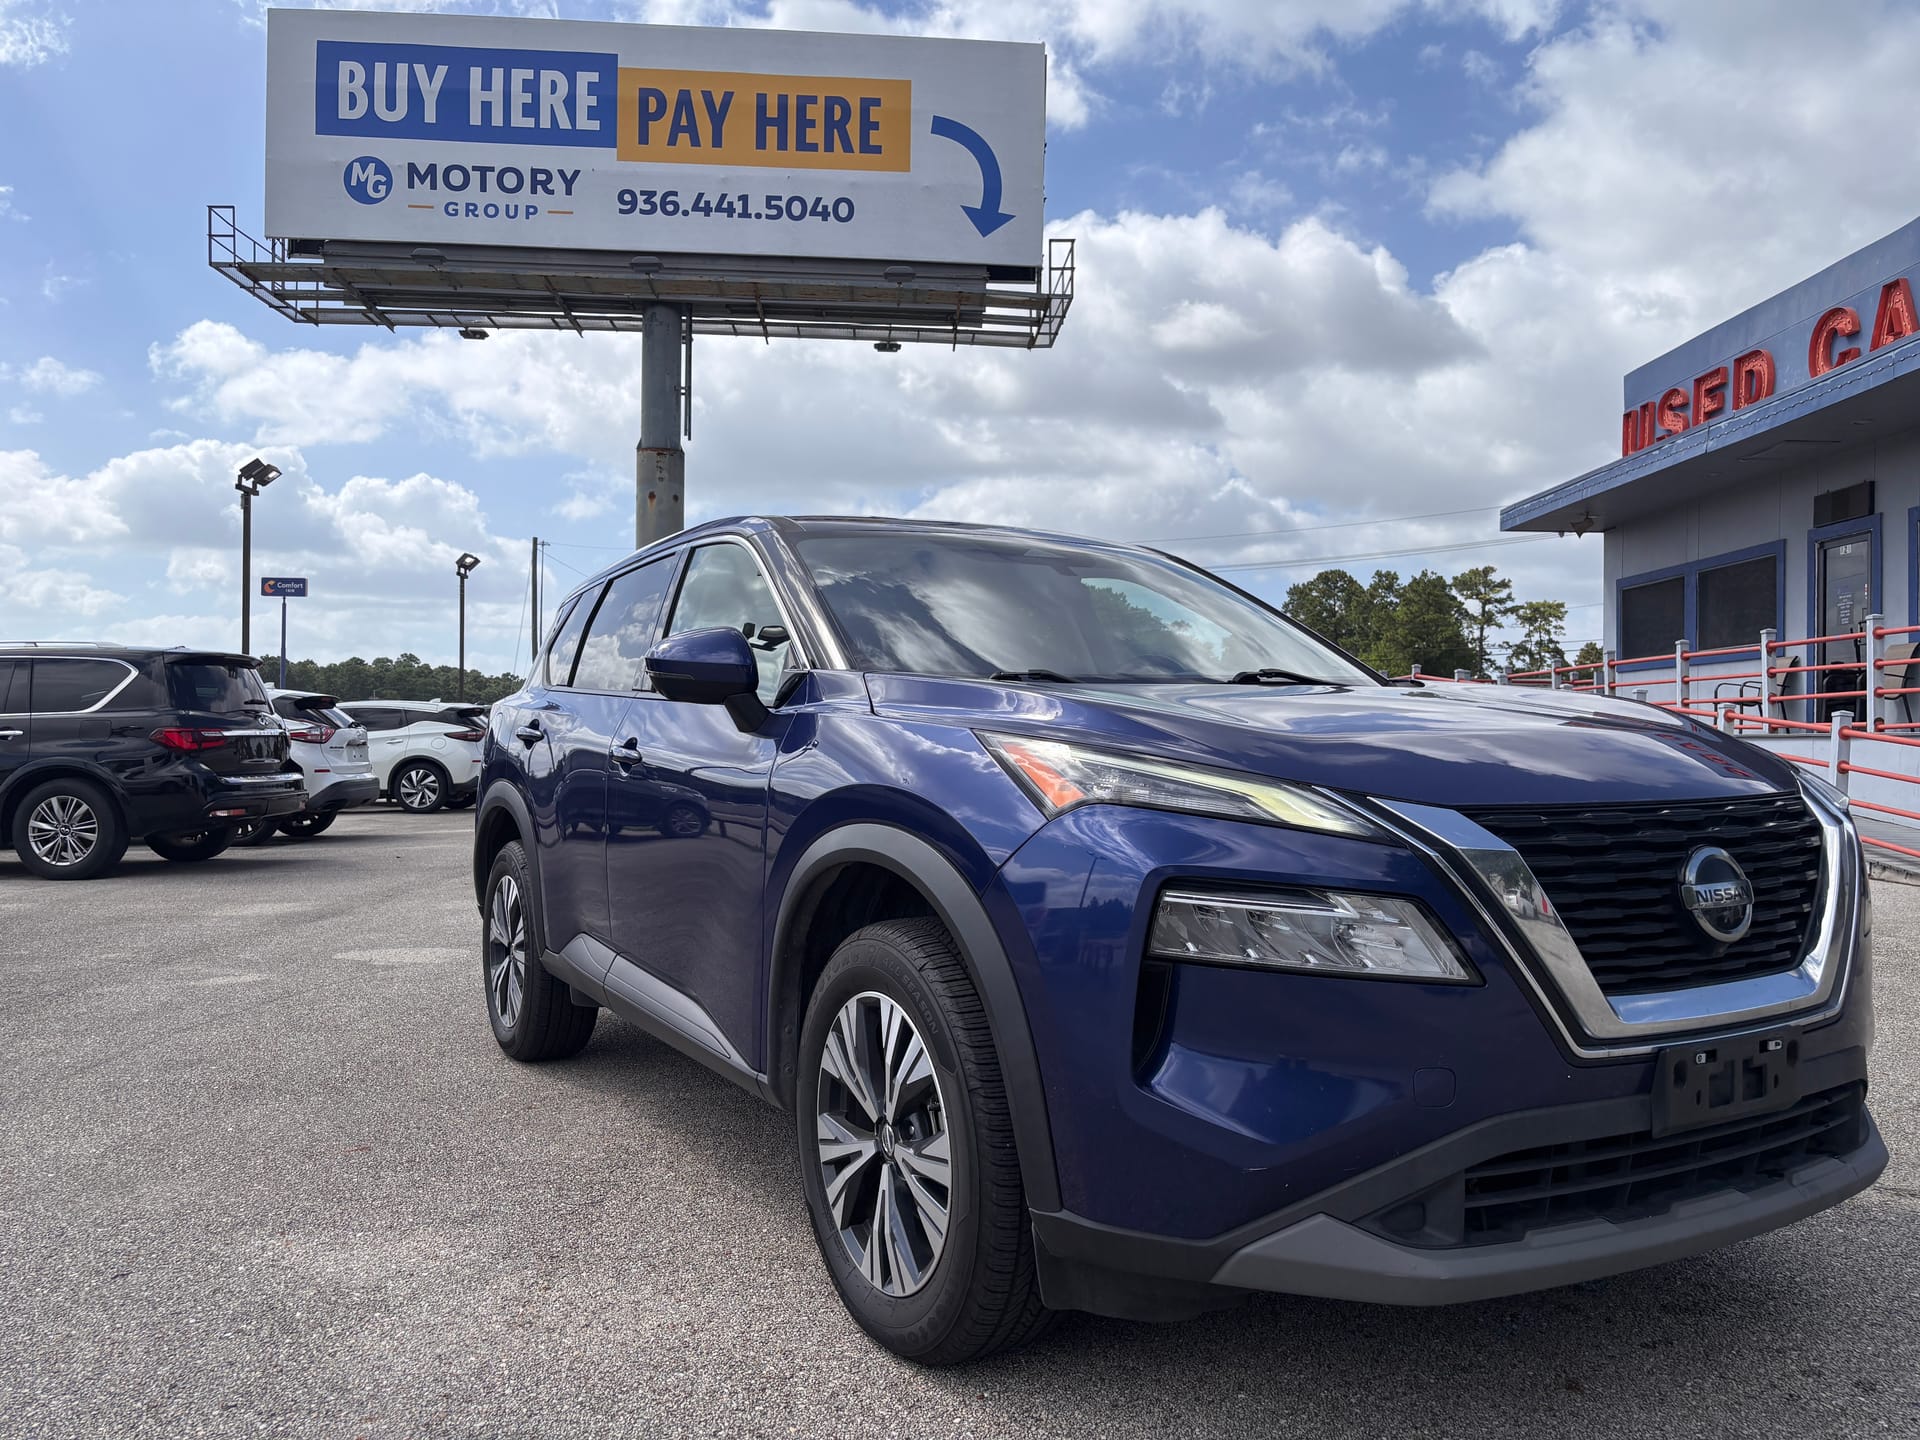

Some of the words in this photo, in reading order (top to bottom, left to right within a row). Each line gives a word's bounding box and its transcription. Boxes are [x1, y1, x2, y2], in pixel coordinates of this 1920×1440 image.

[338, 60, 448, 124] BUY
[469, 66, 600, 131] HERE
[637, 87, 735, 148] PAY
[755, 92, 882, 155] HERE
[351, 162, 387, 199] MG
[407, 162, 581, 196] MOTORY
[443, 201, 539, 220] GROUP
[617, 188, 855, 223] 936.441.5040
[1622, 348, 1776, 458] USED
[1808, 277, 1920, 379] CA
[1695, 885, 1750, 903] NISSAN
